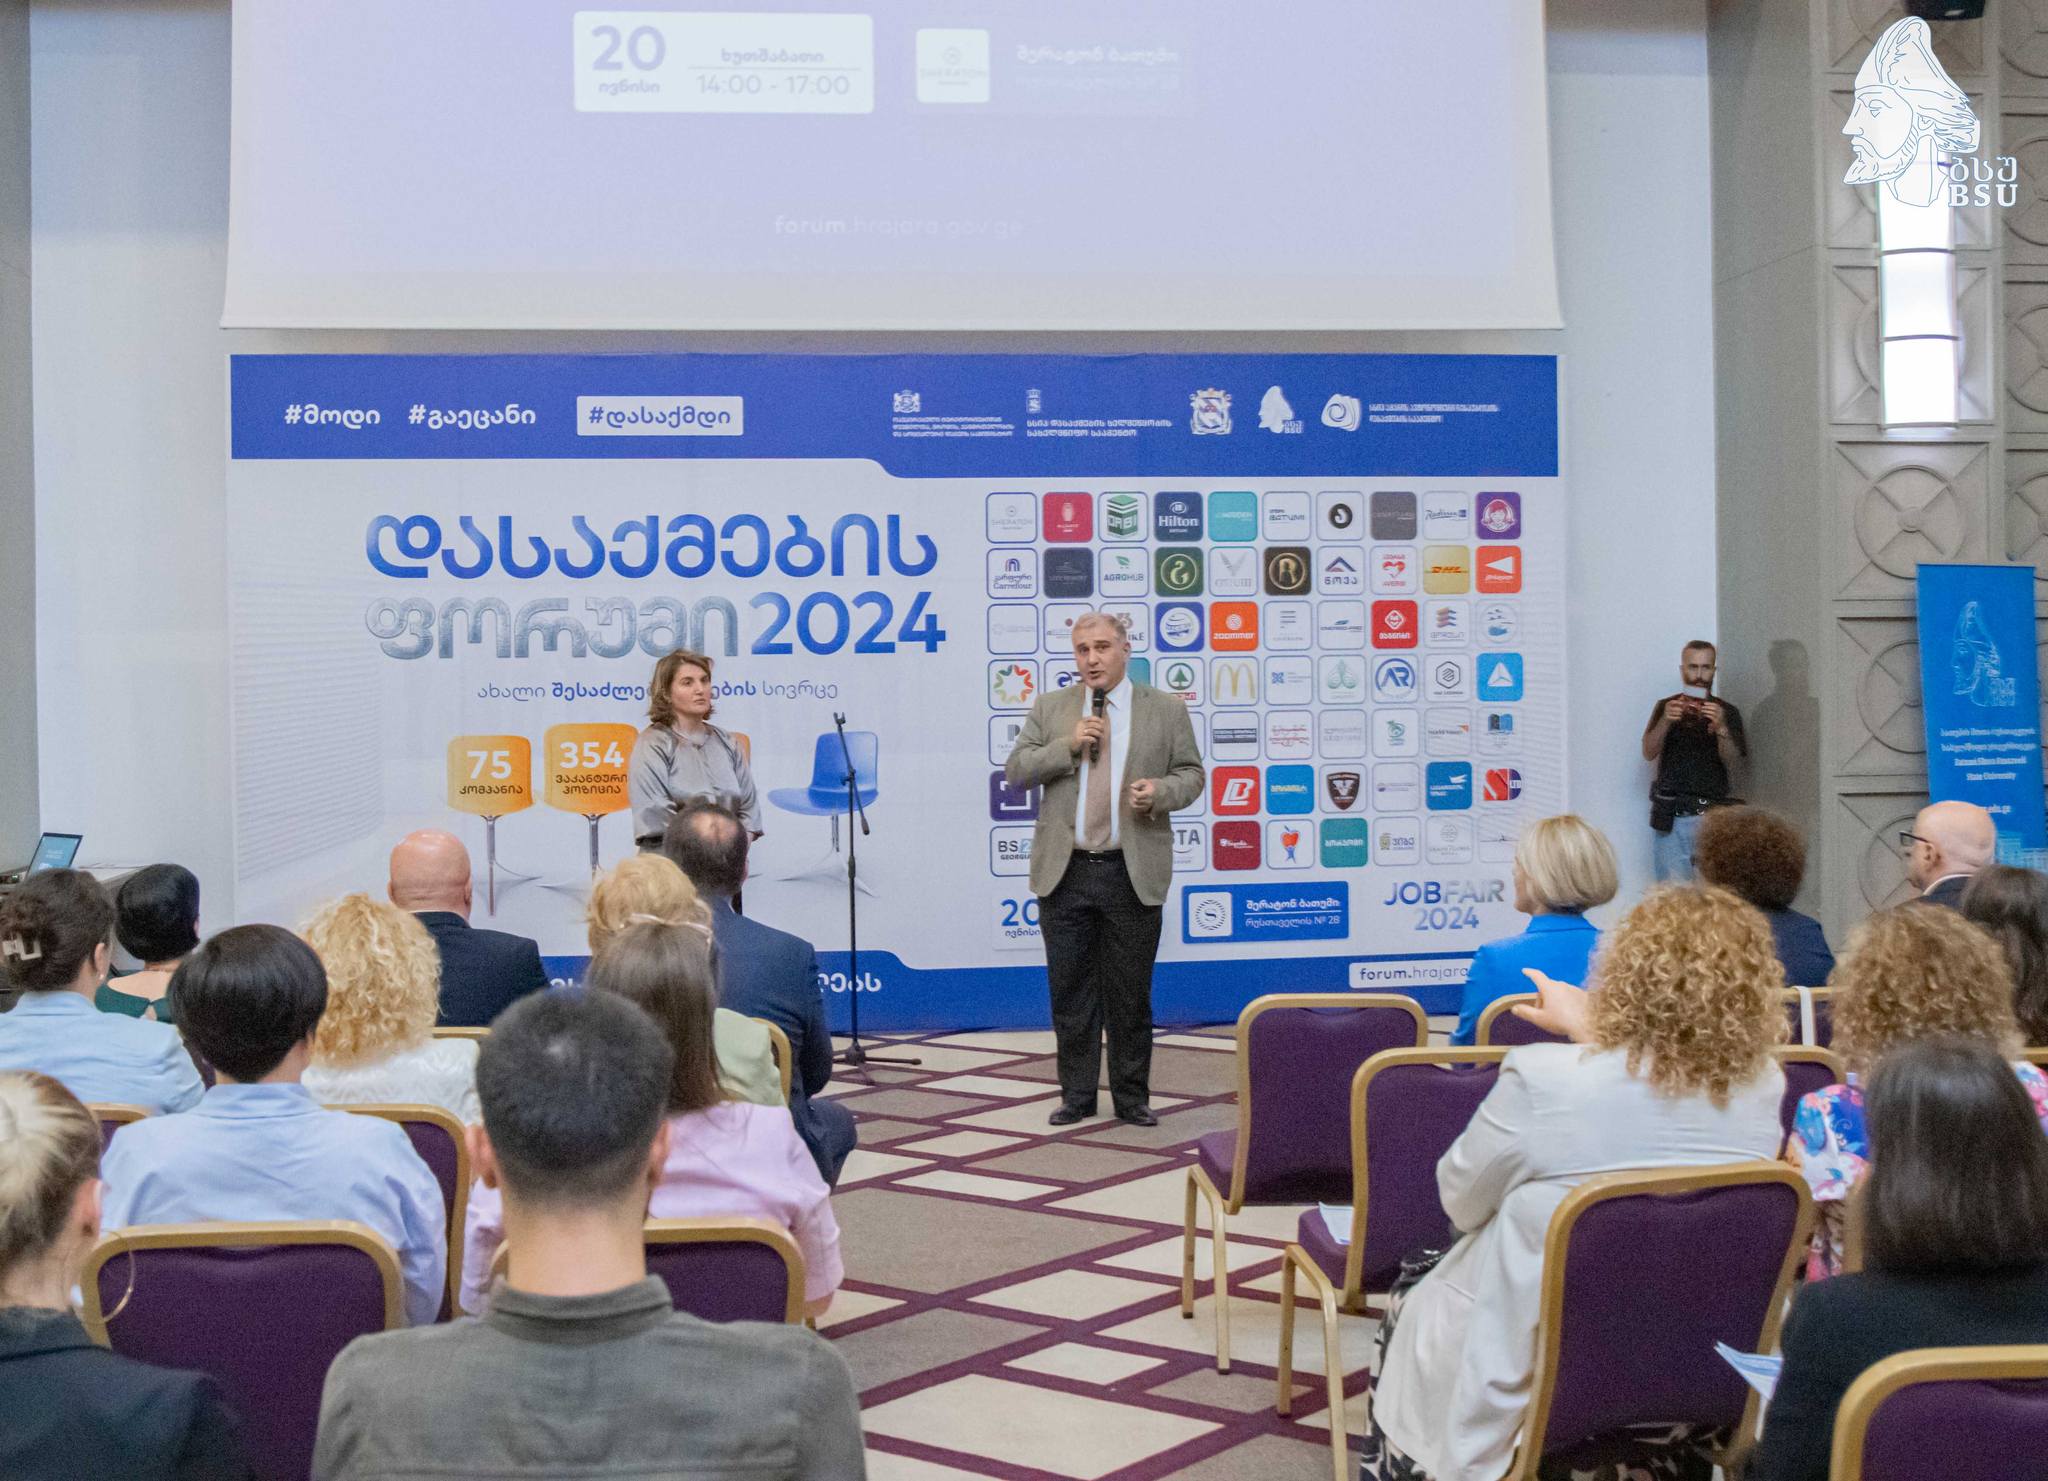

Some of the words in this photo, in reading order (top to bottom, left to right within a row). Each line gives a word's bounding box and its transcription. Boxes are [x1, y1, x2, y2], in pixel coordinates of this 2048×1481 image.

[591, 25, 667, 72] 20
[696, 75, 762, 95] 14:00
[787, 75, 850, 95] 17:00
[284, 403, 381, 430] #მოდი
[408, 403, 537, 430] #გაეცანი
[588, 404, 732, 429] #დასაქმდი
[1158, 515, 1200, 528] Hilton
[365, 512, 939, 580] დასაქმების
[365, 595, 740, 660] ფორუმი
[749, 590, 947, 657] 2024
[477, 682, 546, 702] ახალი
[762, 681, 839, 699] სივრცე
[466, 751, 512, 780] 75
[559, 742, 625, 769] 354
[459, 784, 524, 796] კომპანია
[1000, 898, 1041, 927] 20
[1414, 906, 1480, 931] 2024
